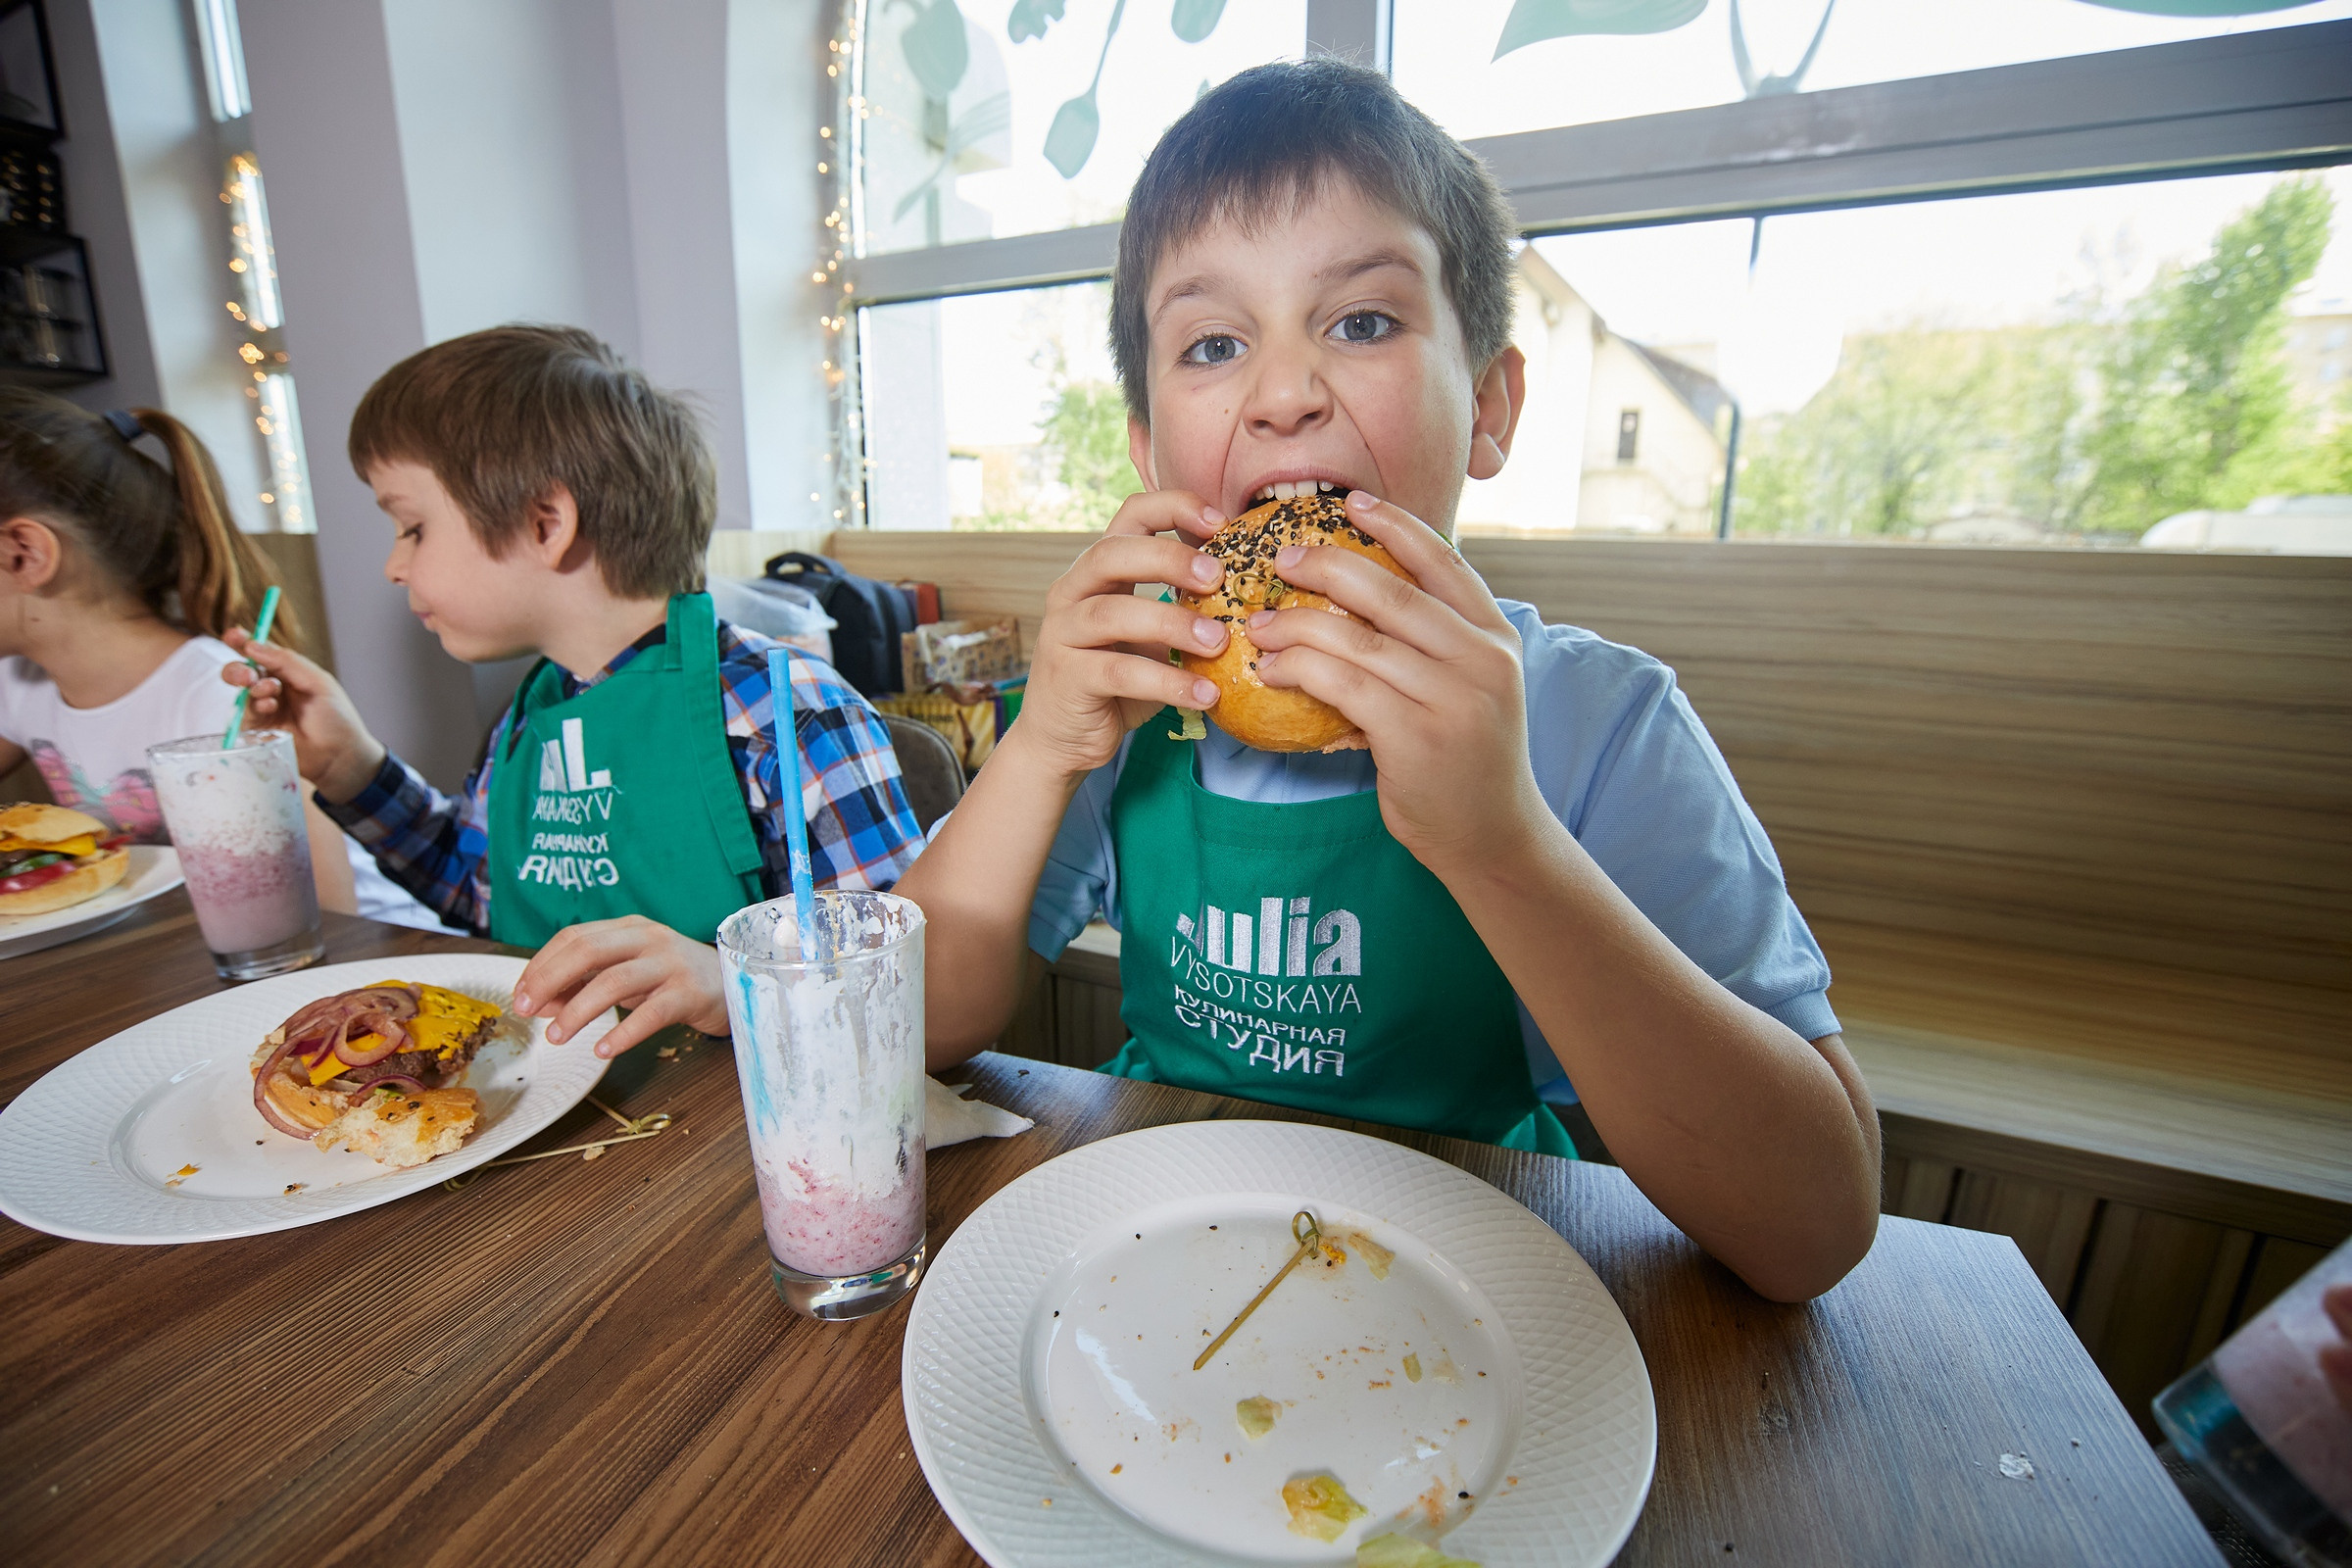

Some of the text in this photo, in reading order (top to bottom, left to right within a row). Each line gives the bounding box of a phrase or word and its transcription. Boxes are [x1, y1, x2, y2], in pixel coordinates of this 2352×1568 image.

[1170, 936, 1362, 1014] VYSOTSKAYA
[1174, 984, 1347, 1047] КУЛИНАРНАЯ
[1174, 1004, 1346, 1077] СТУДИЯ
